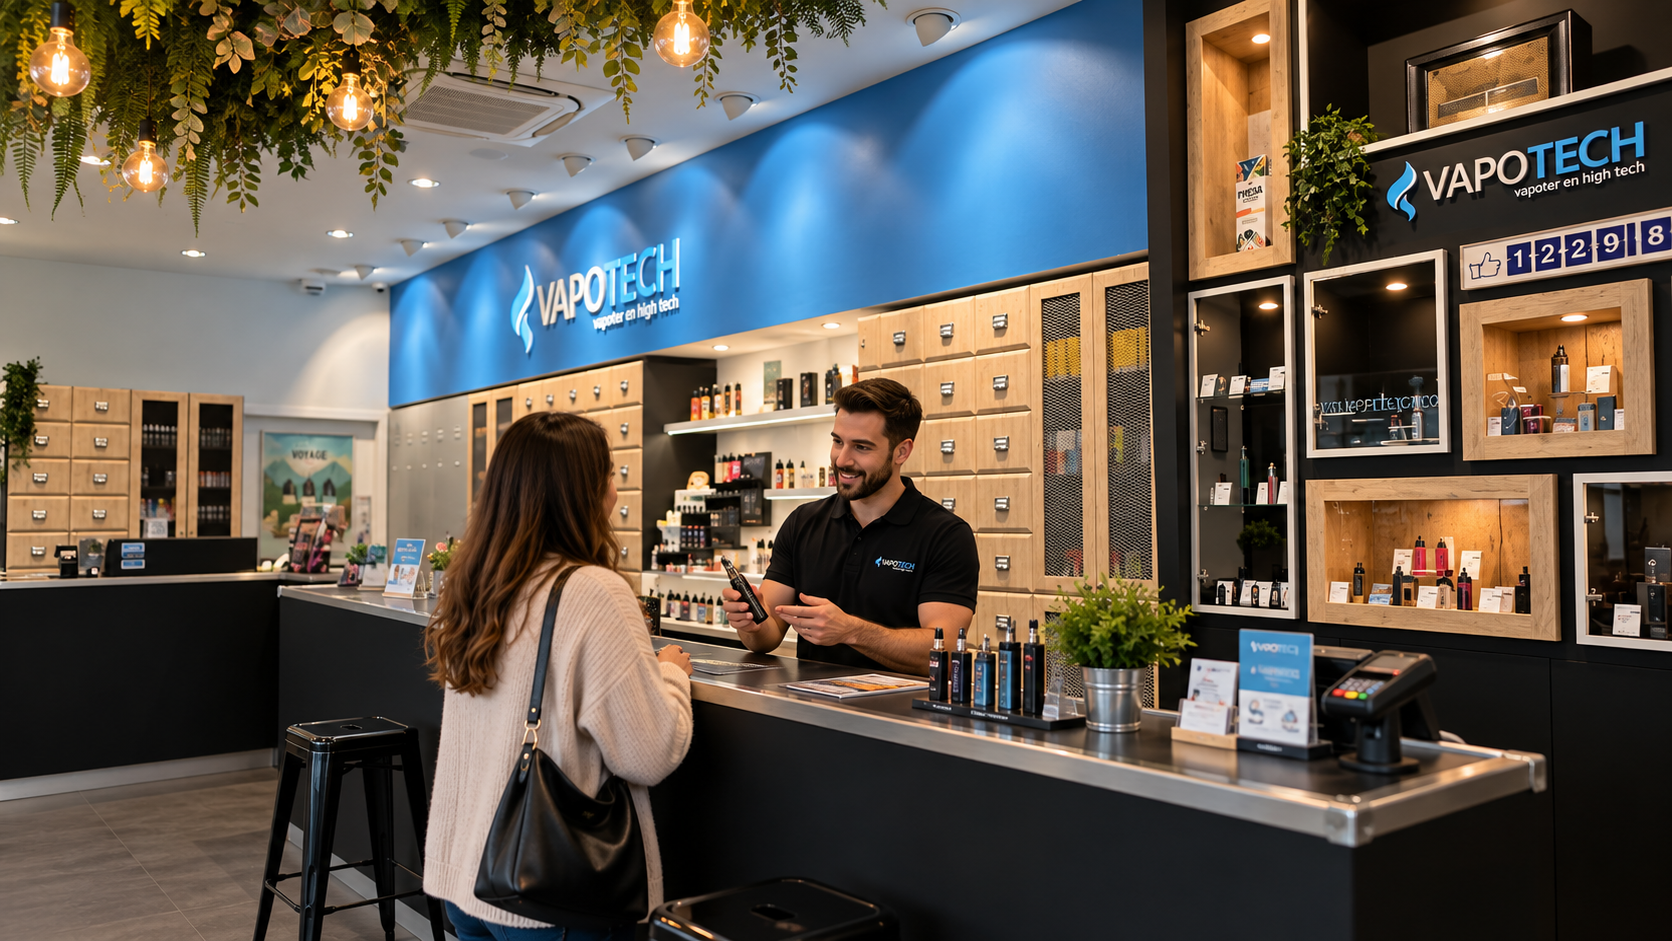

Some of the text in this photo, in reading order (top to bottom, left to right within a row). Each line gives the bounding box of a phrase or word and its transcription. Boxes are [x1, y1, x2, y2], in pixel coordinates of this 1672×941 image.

[1423, 121, 1645, 201] VAPOTECH
[1514, 160, 1646, 198] vapoter en high tech
[536, 238, 681, 326] VAPOTECH
[592, 293, 679, 330] vapoter en high tech
[291, 449, 328, 461] VOYAGE
